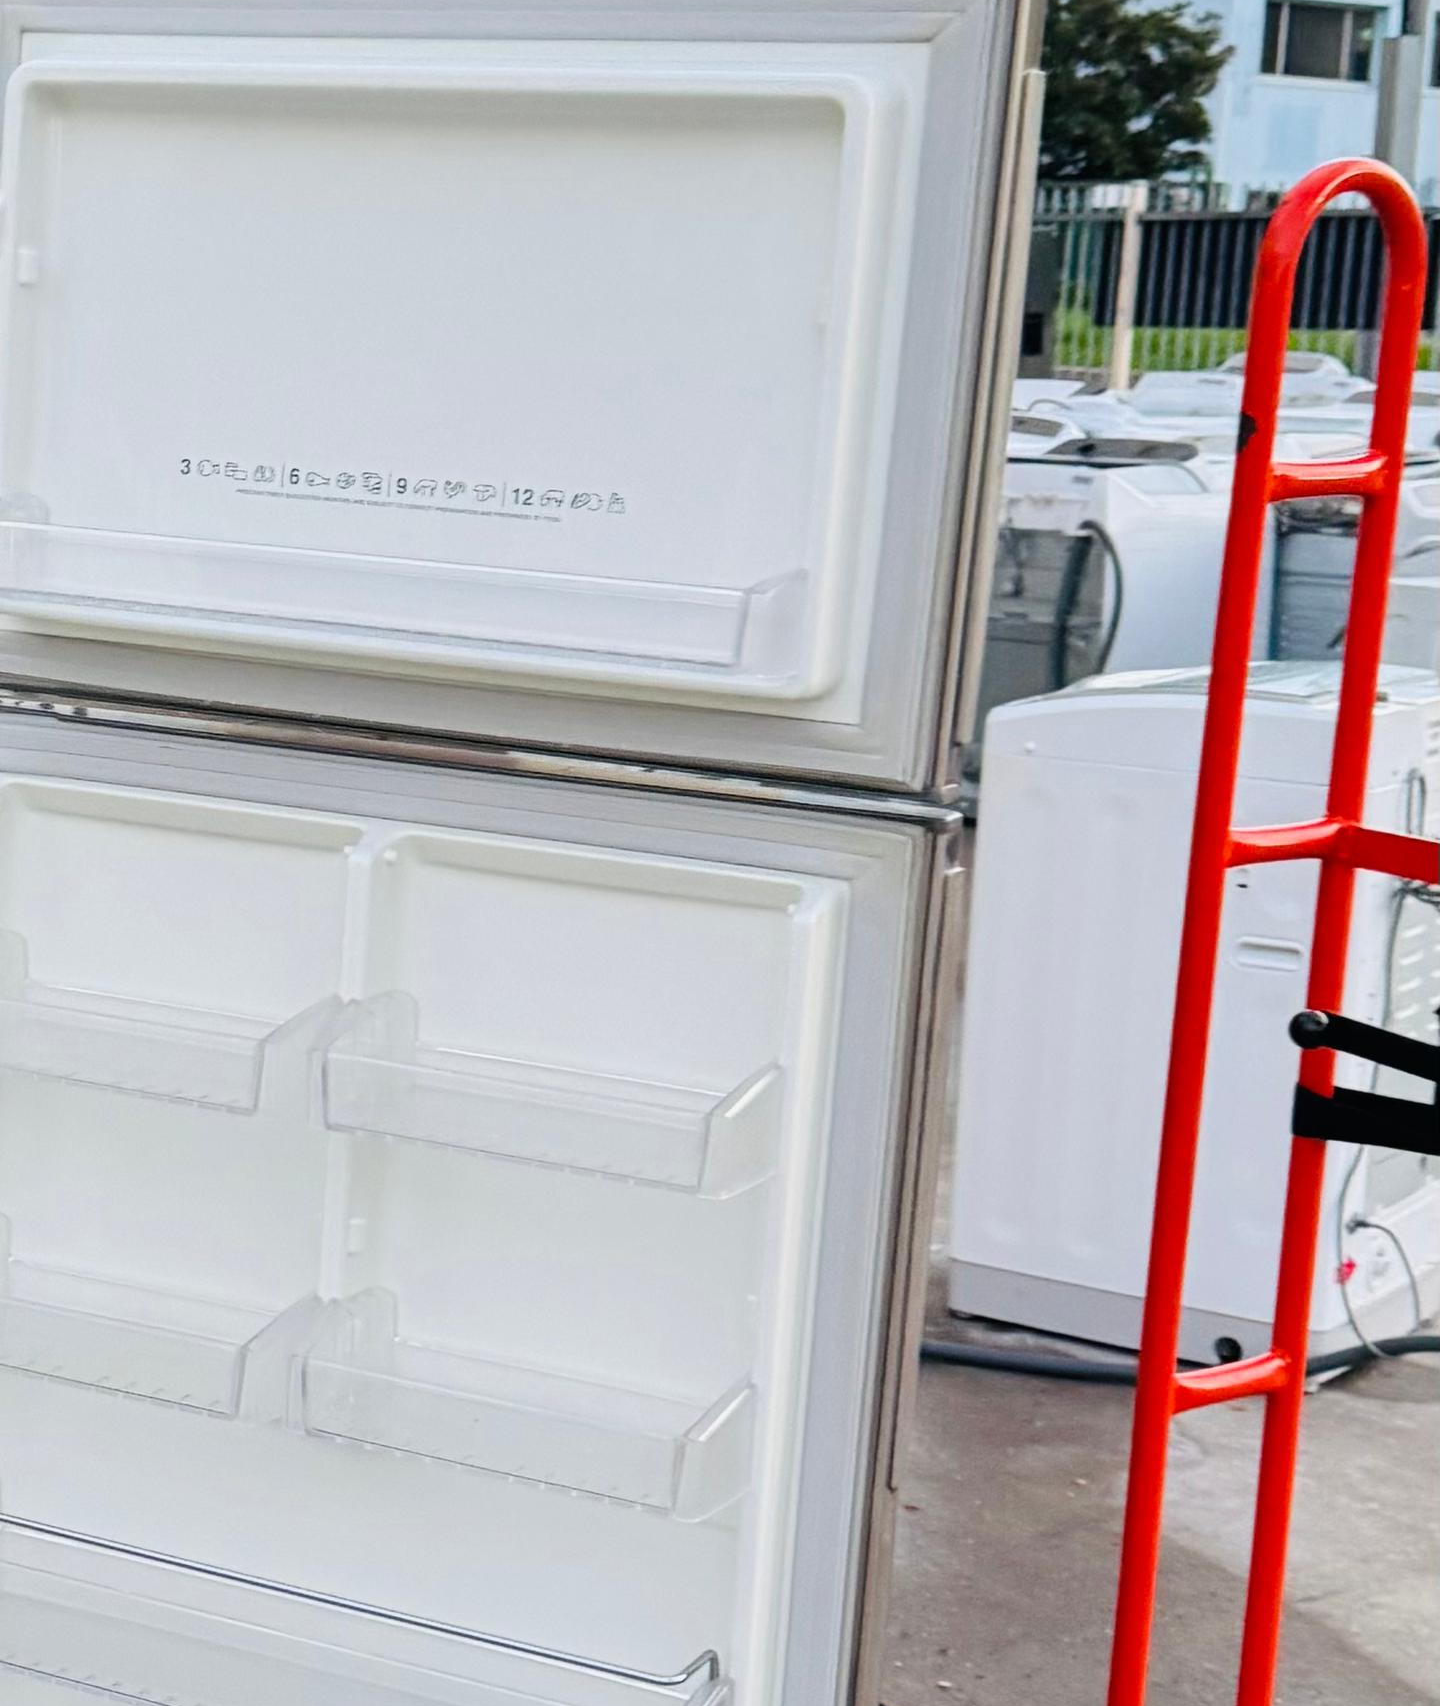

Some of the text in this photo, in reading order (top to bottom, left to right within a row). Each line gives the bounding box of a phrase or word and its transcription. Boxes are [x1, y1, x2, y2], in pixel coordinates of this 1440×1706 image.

[180, 458, 534, 506] 3 6 9 12
